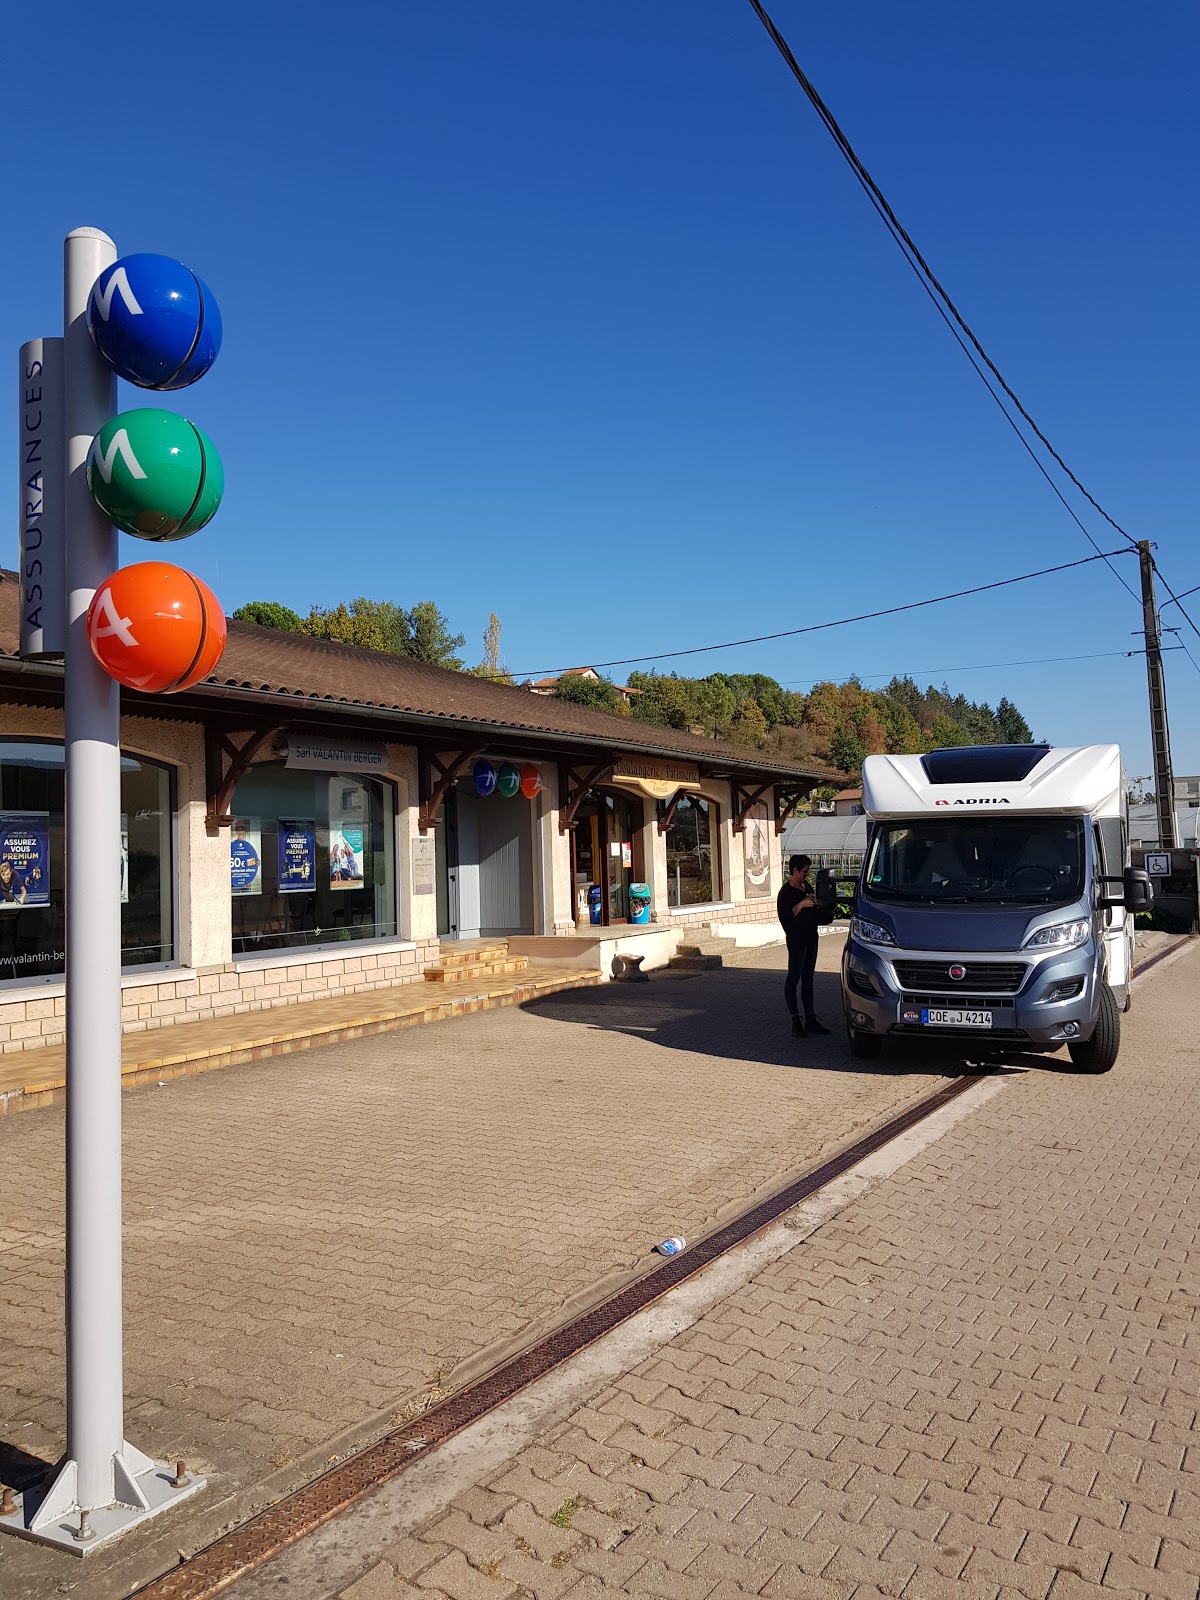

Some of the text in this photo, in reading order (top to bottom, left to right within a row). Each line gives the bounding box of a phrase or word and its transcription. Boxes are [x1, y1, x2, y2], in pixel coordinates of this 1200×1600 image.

[25, 360, 43, 629] ASSURANCES
[91, 587, 140, 655] A
[296, 746, 382, 764] Sarl VALANTIN BERGER
[953, 797, 1010, 805] ADRIA
[3, 838, 37, 846] ASSUREZ
[10, 845, 31, 853] VOUS
[2, 852, 39, 860] PREMIUM
[929, 1010, 992, 1024] COE J 4214
